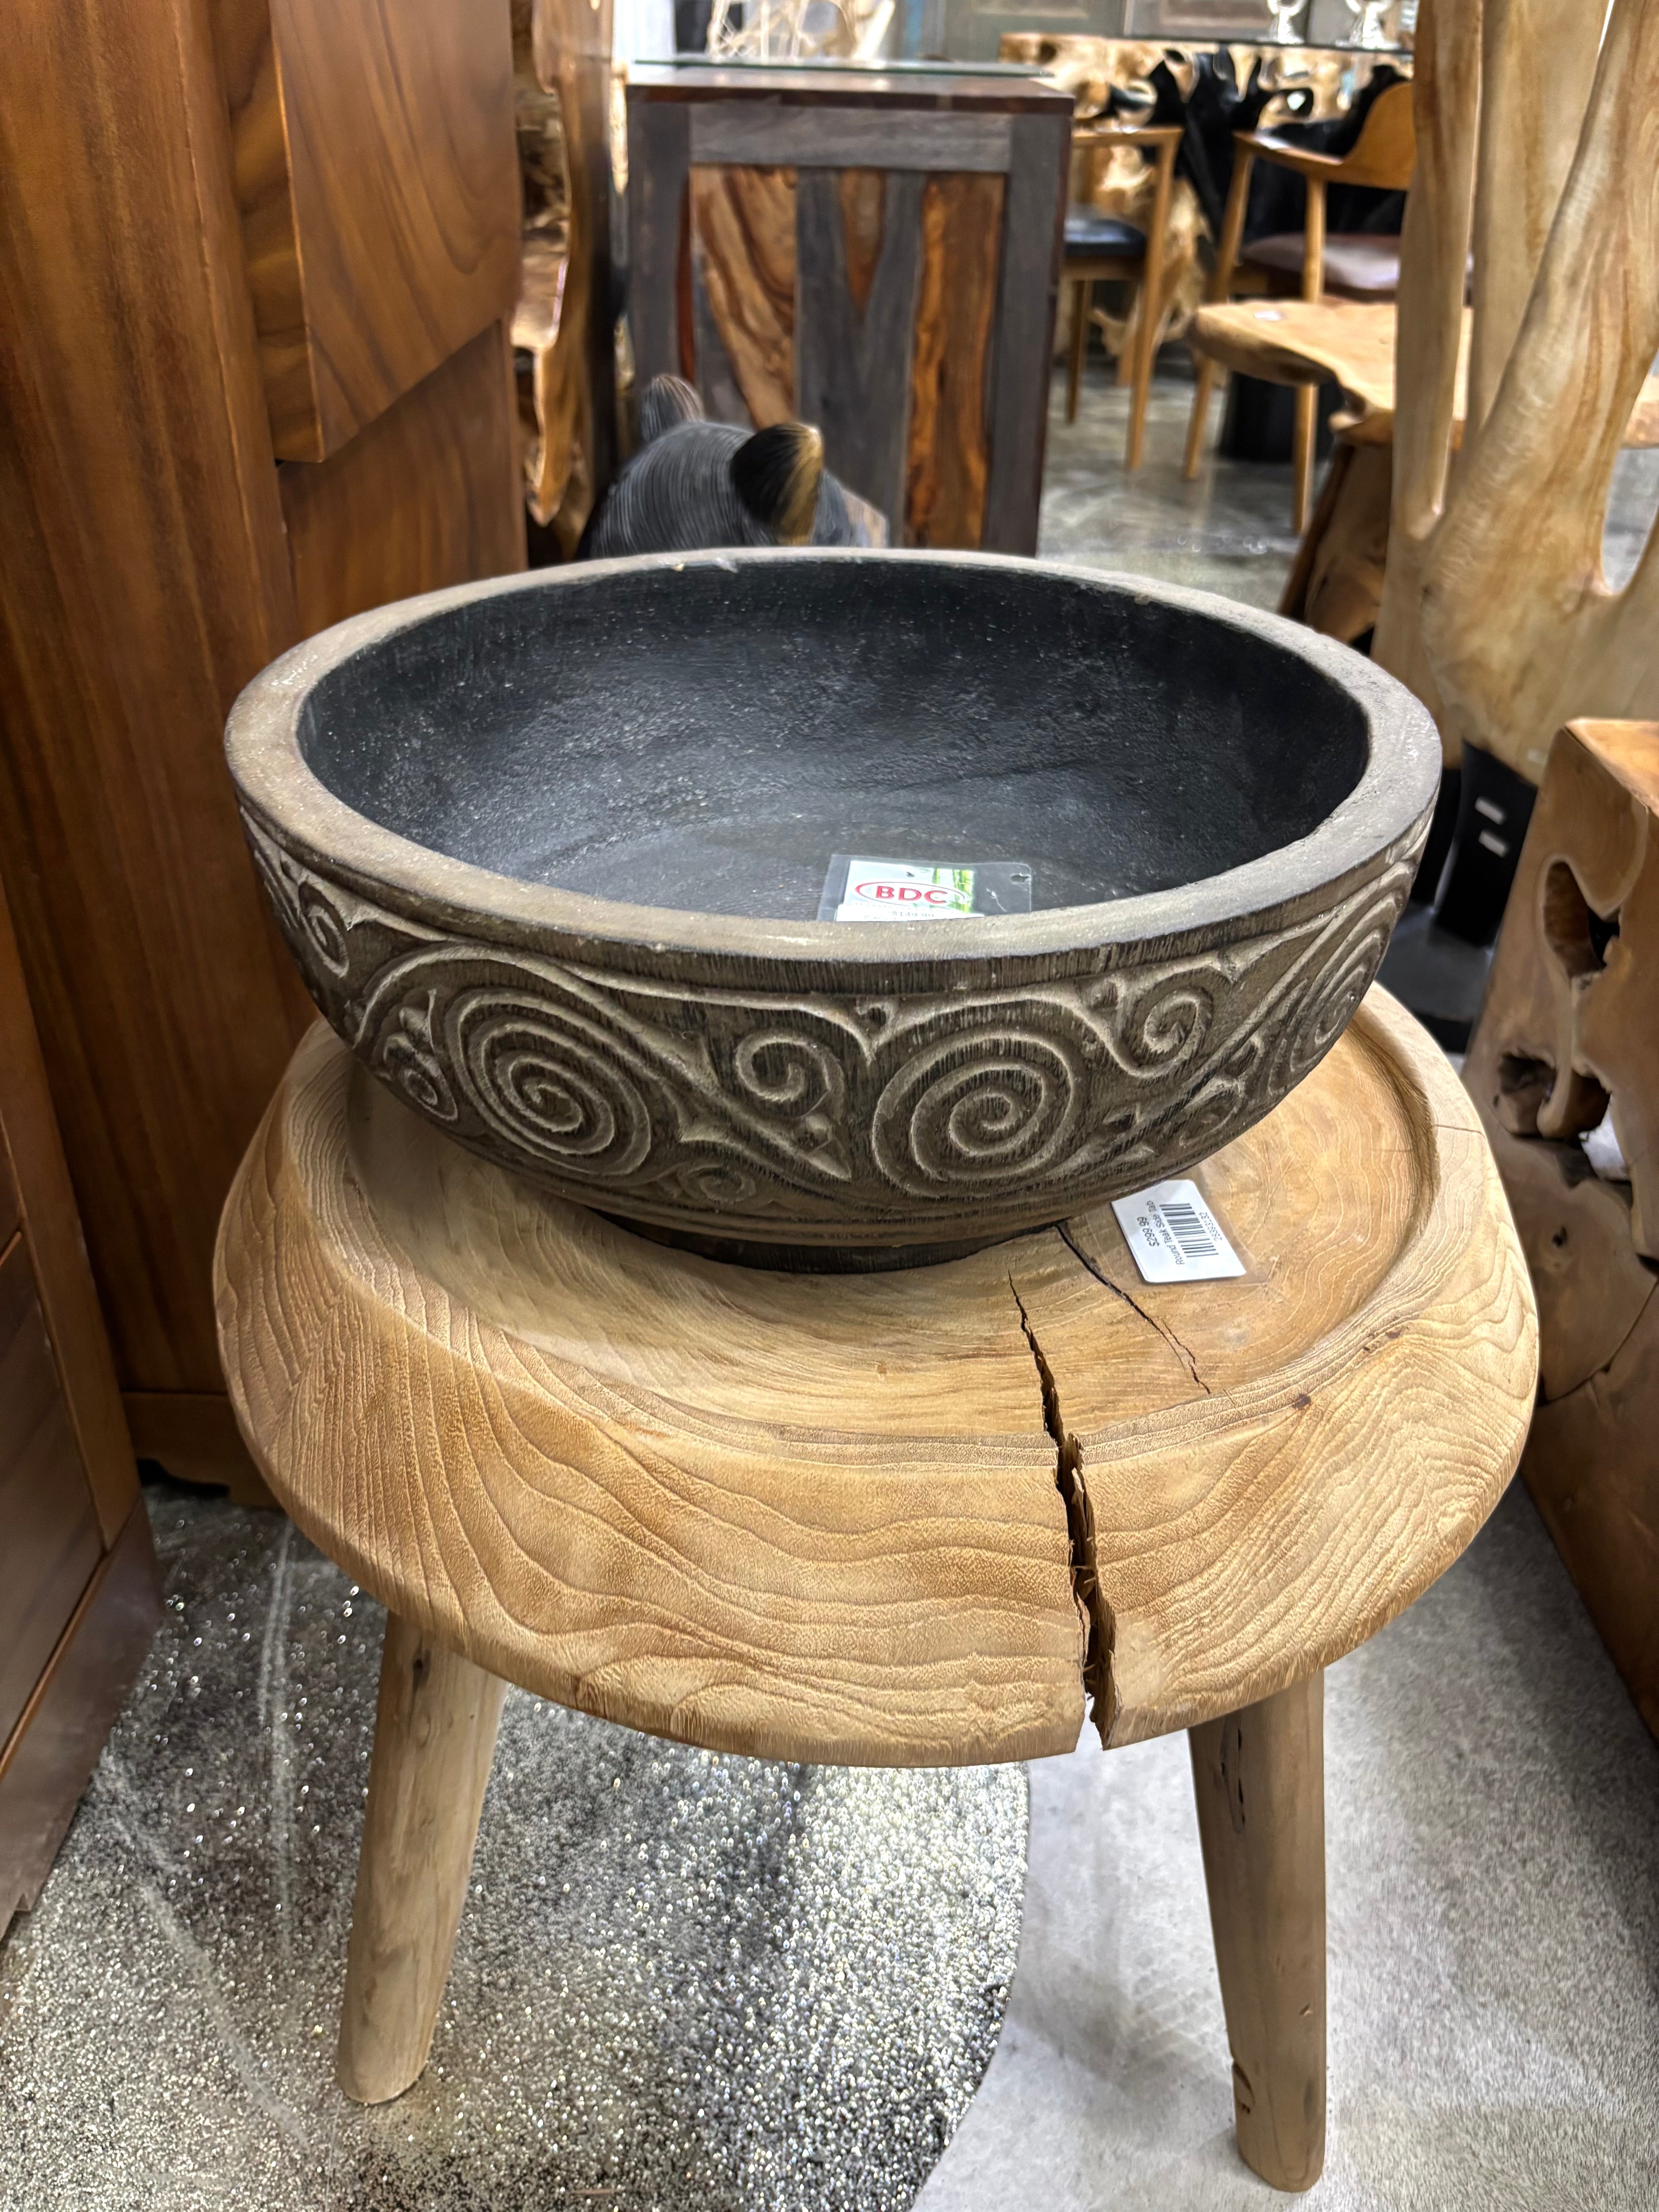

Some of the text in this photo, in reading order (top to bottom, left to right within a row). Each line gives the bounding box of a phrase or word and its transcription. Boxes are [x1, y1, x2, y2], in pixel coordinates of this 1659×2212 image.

[875, 885, 948, 904] BDC
[1137, 1217, 1160, 1247] $299.99
[1146, 1200, 1185, 1265] Round Teak Side Tab
